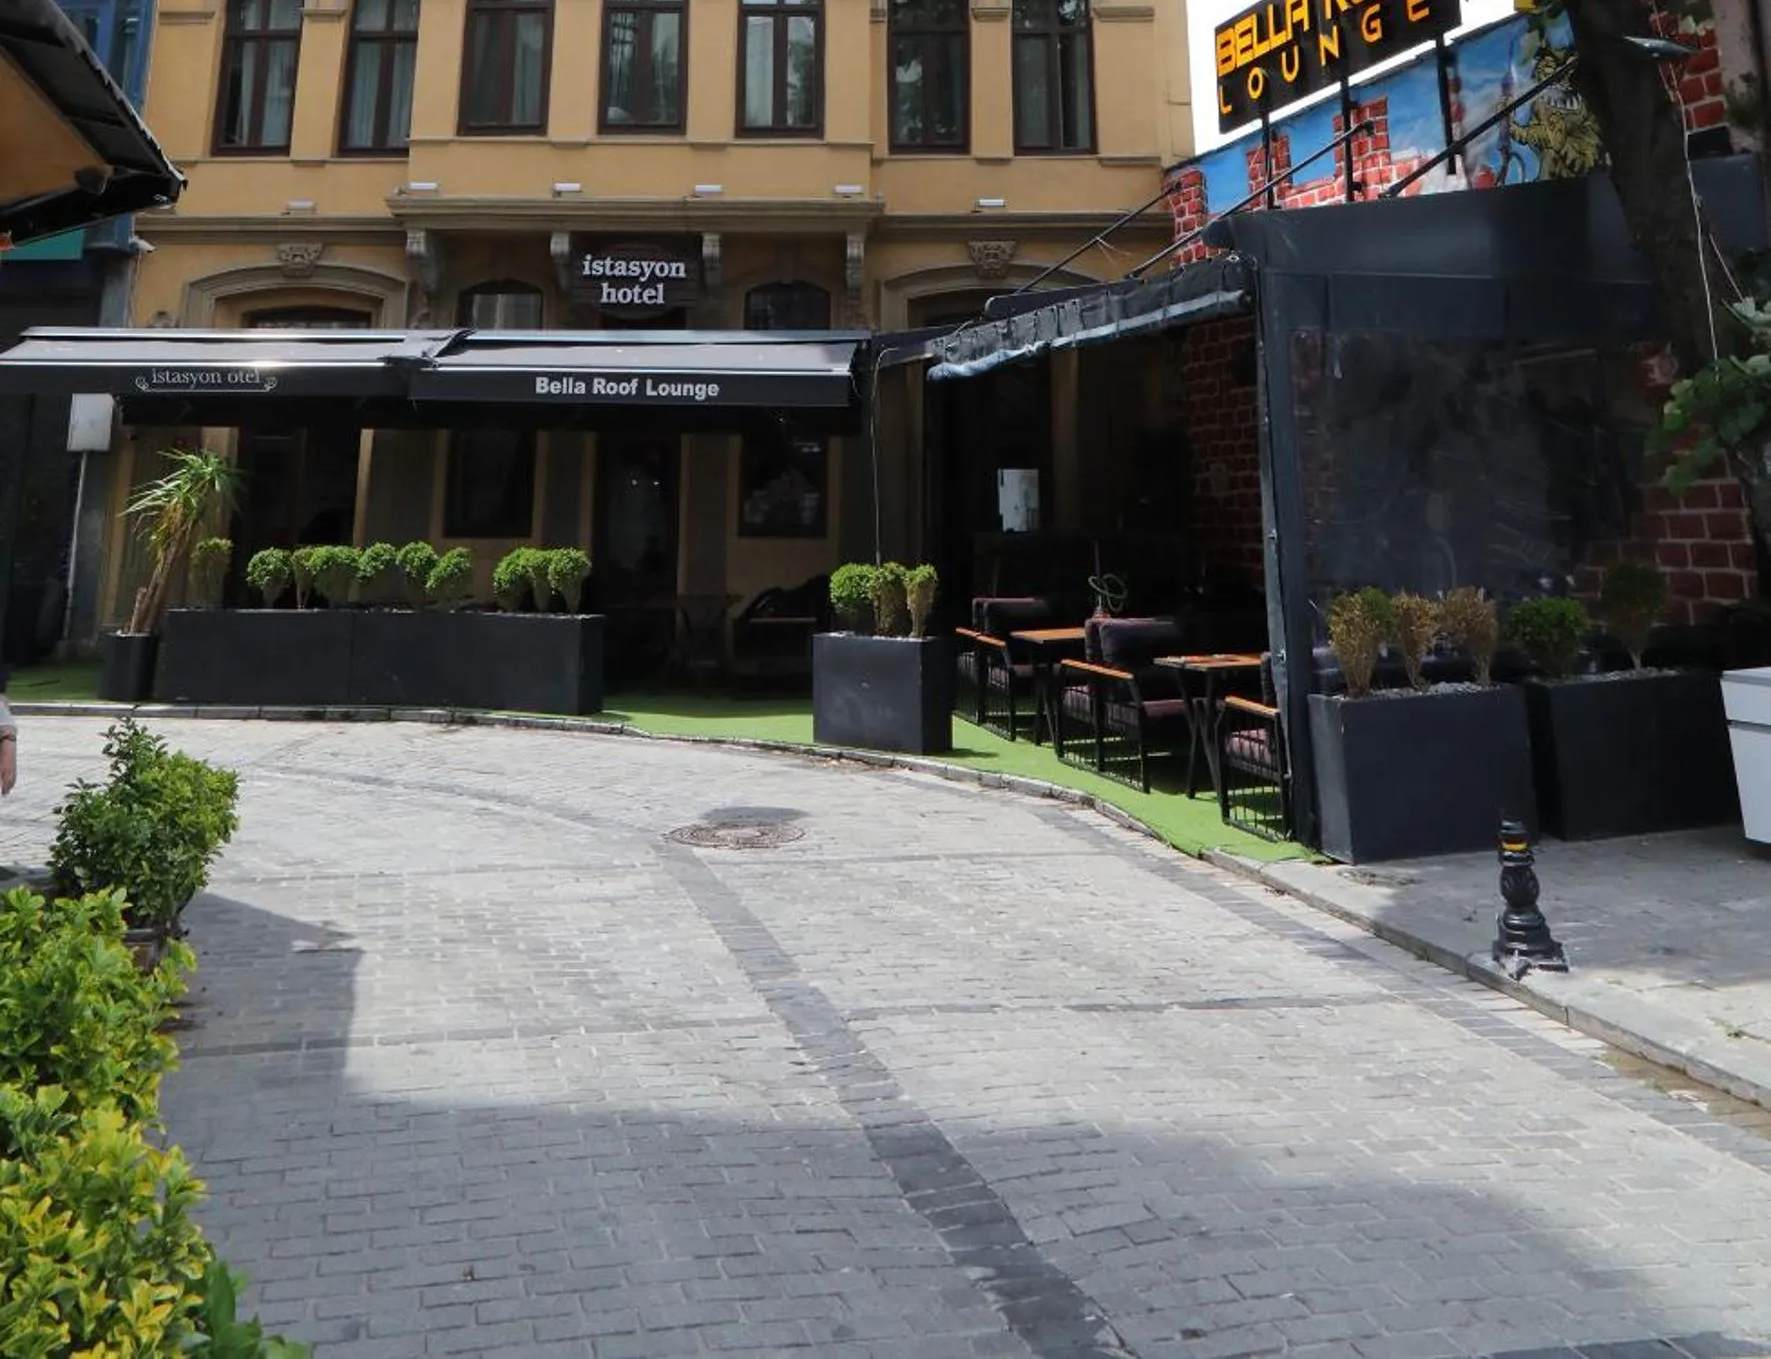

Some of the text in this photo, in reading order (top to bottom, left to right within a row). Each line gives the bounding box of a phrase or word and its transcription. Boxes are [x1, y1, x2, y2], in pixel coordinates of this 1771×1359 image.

[582, 253, 686, 282] istasyon
[600, 282, 665, 304] hotel
[227, 366, 262, 384] otel
[535, 376, 720, 401] Bella Roof Lounge
